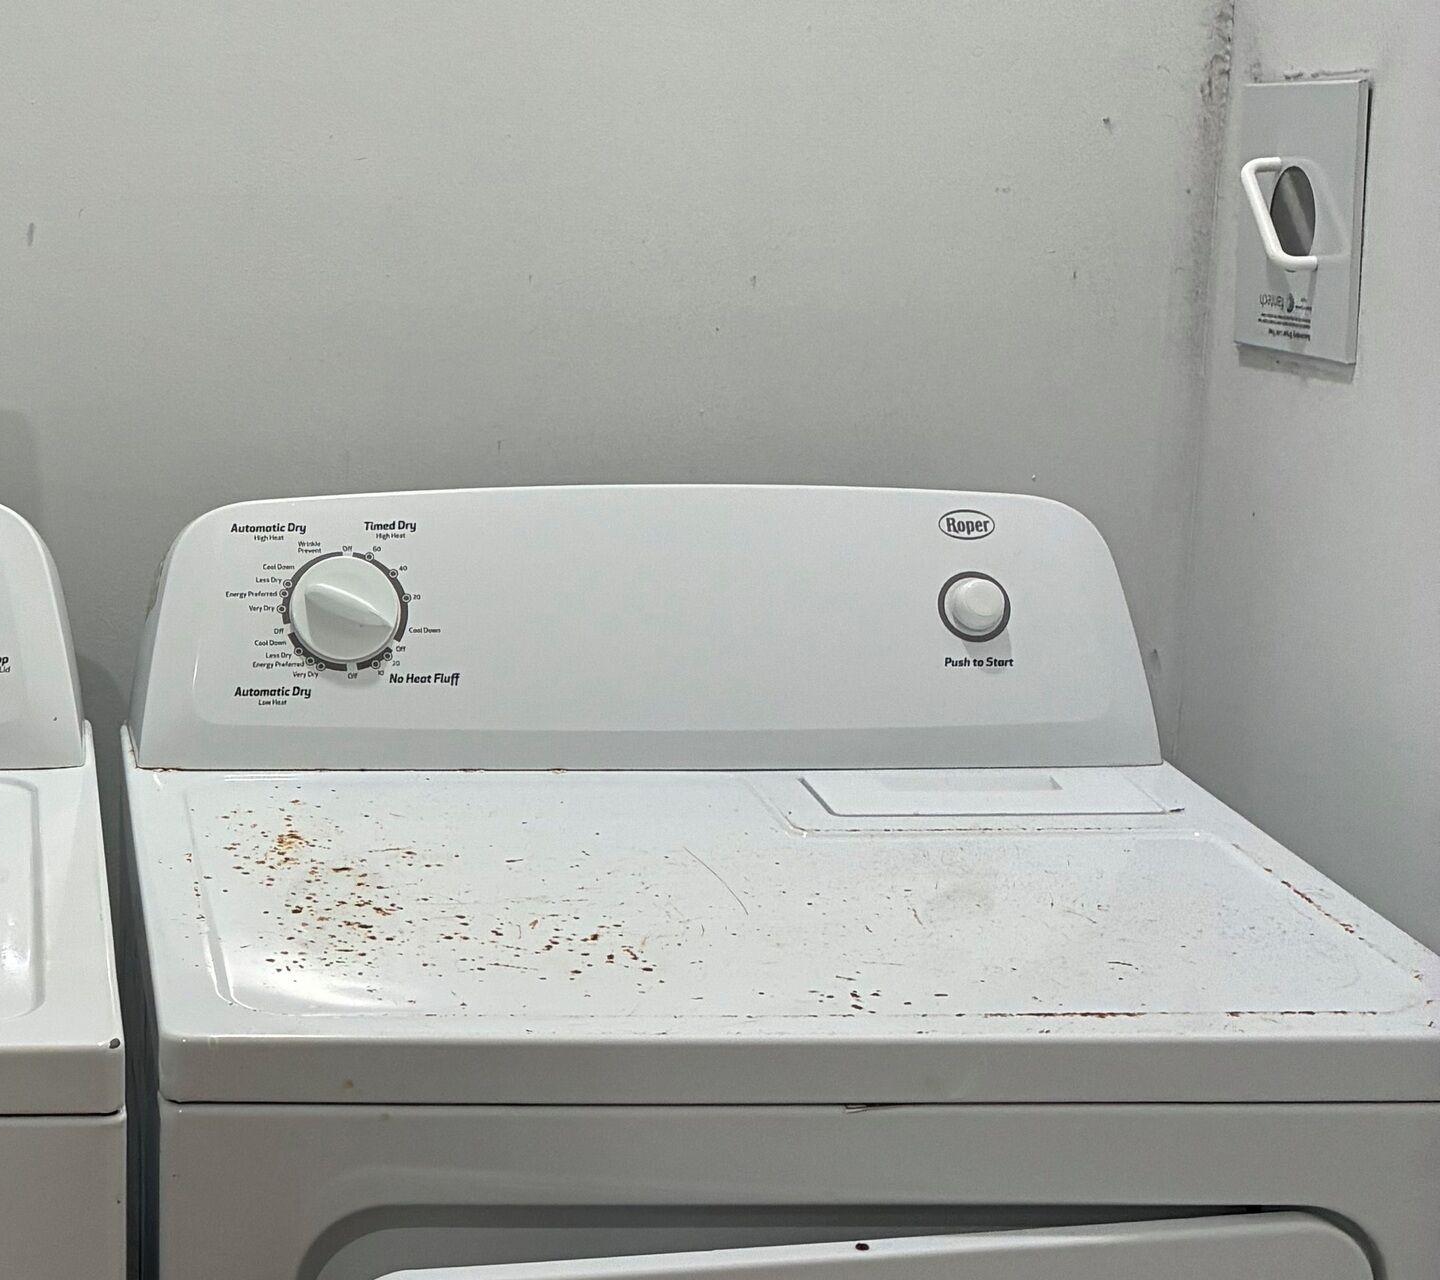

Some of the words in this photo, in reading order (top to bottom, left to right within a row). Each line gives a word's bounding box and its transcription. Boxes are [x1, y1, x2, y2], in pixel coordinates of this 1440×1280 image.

[230, 523, 286, 533] Automatic
[287, 522, 307, 534] Dry
[364, 520, 396, 531] Timed
[397, 520, 417, 532] Dry
[946, 517, 990, 535] Roper
[944, 657, 970, 667] Push
[973, 658, 984, 667] to
[985, 656, 1014, 667] Start
[389, 673, 404, 684] No
[405, 673, 432, 684] Heat
[433, 672, 461, 686] Fluff
[234, 686, 290, 697] Automatic
[292, 686, 312, 699] Dry
